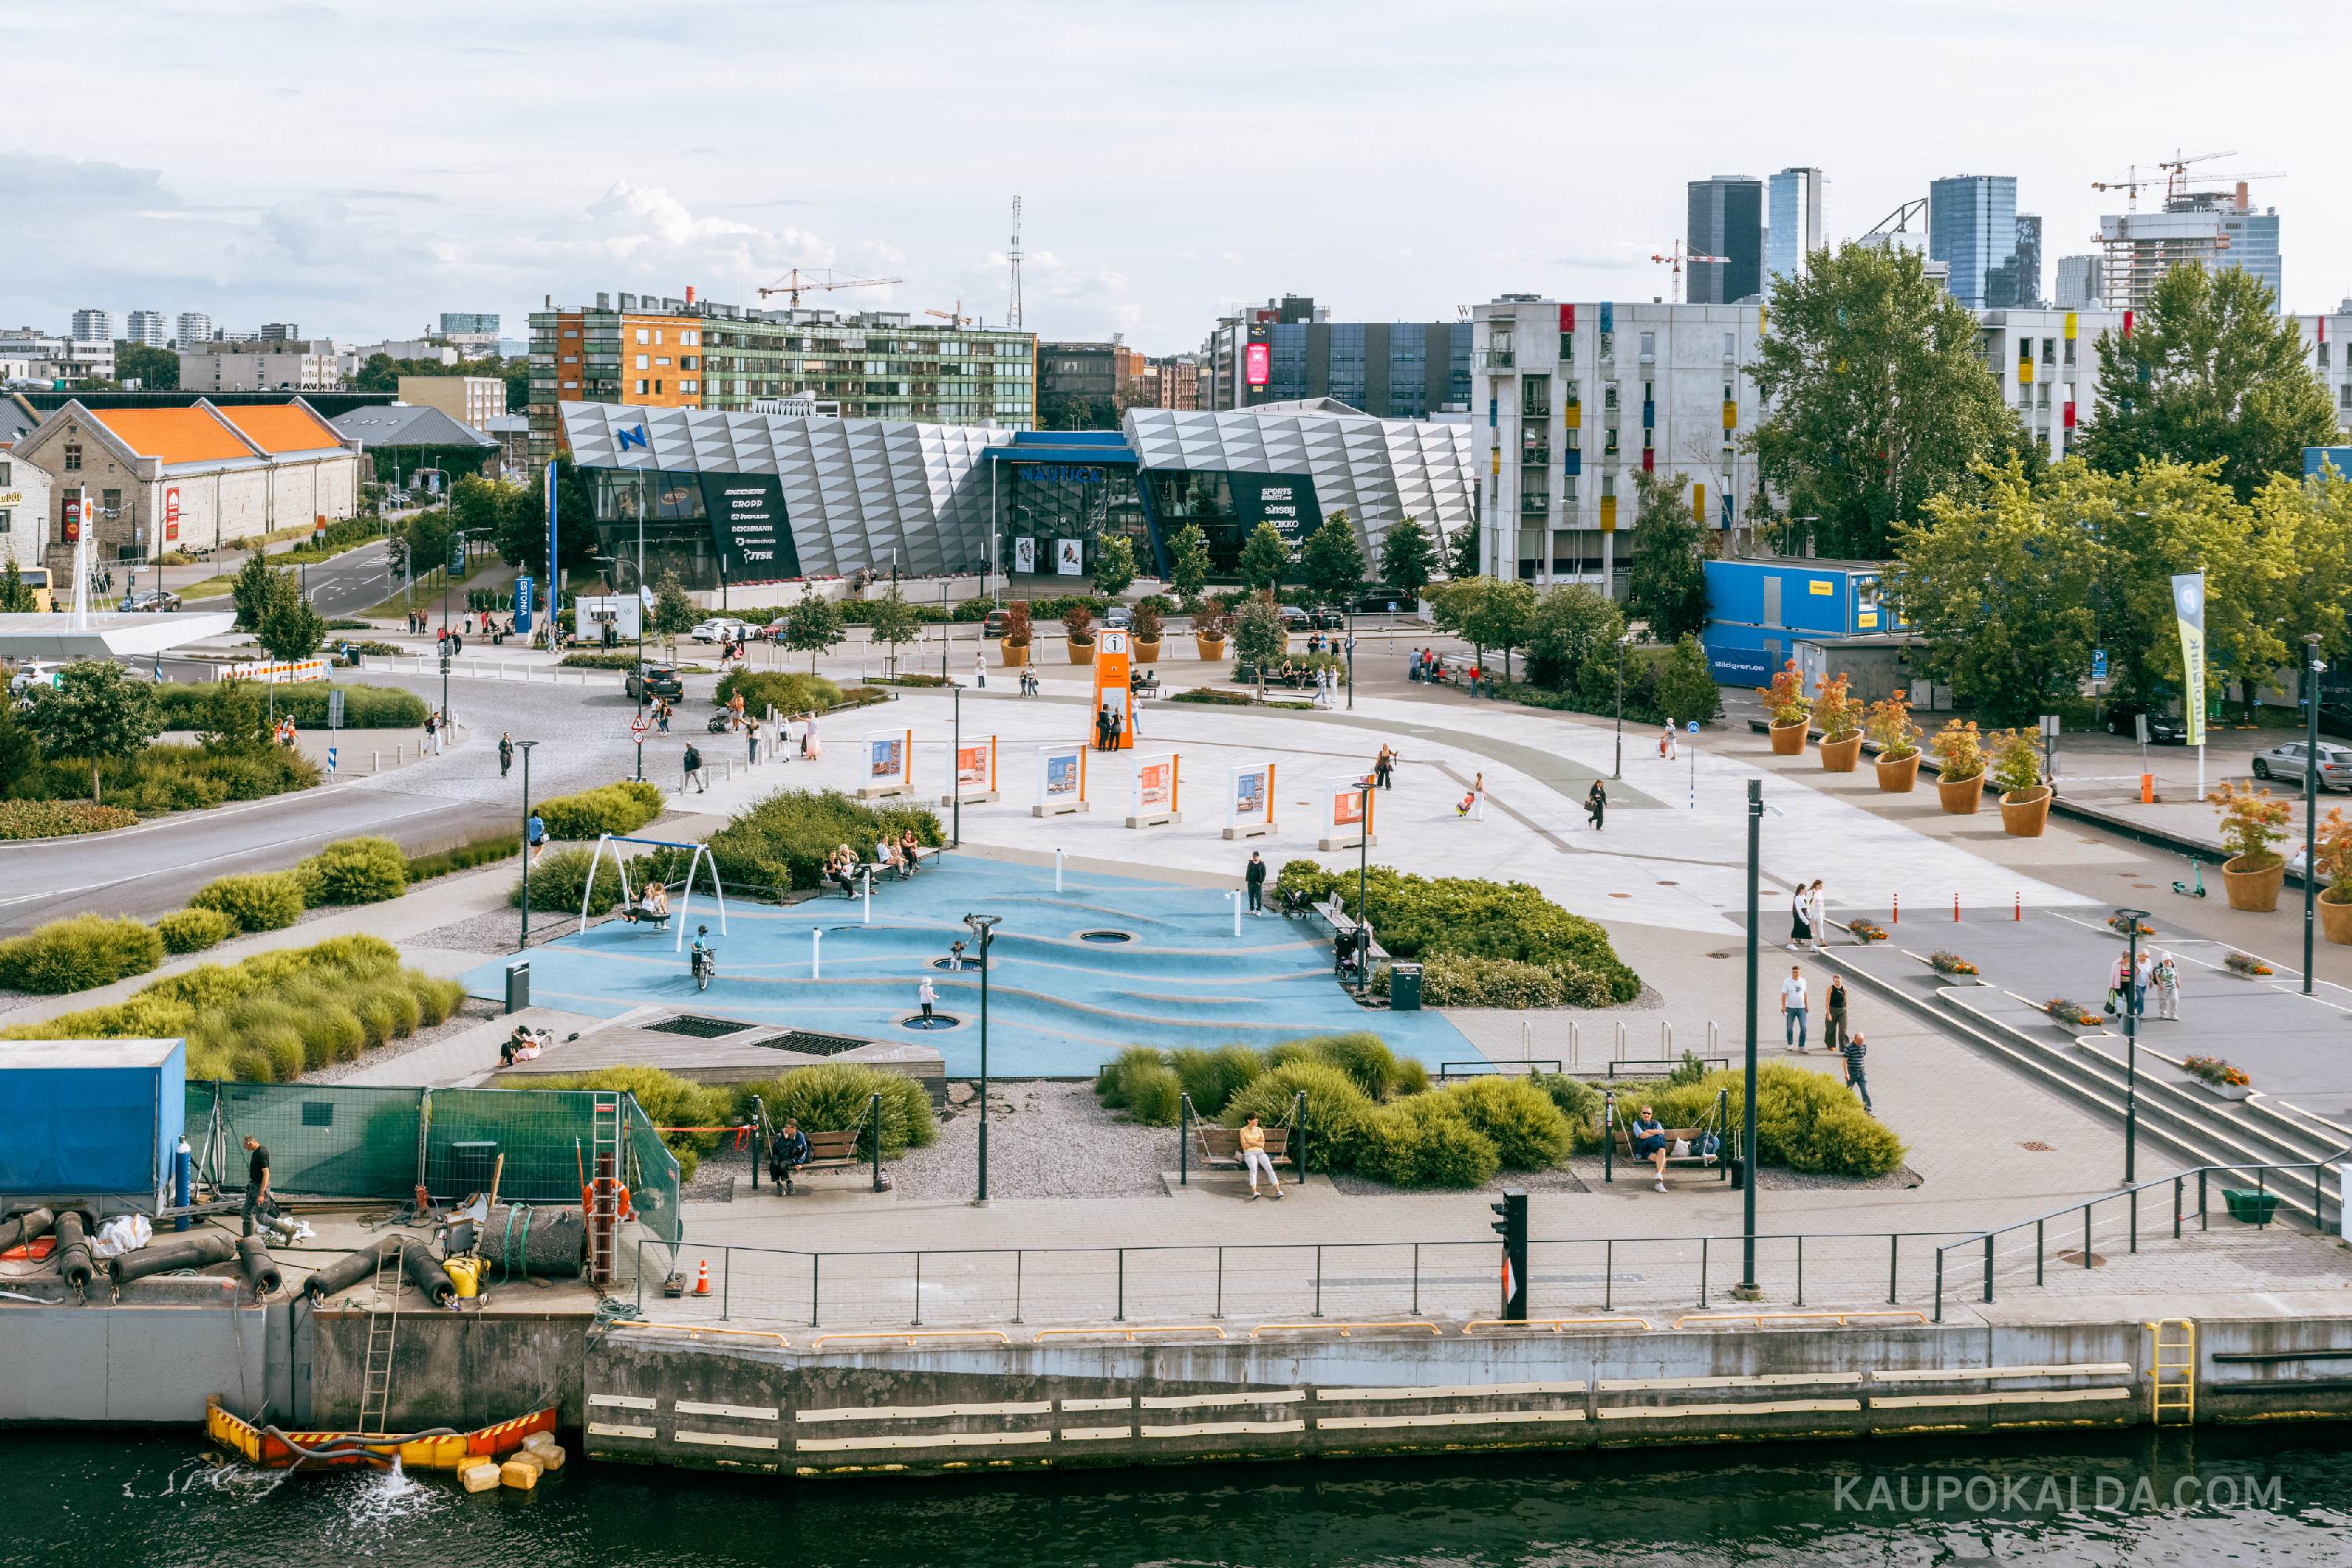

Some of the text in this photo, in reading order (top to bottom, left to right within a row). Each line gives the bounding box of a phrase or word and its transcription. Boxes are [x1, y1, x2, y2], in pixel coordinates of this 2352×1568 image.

[1022, 465, 1102, 484] NAUTICA
[731, 499, 763, 508] CROPP
[1265, 504, 1296, 517] sinsay
[749, 550, 774, 561] JYSK
[1715, 661, 1765, 671] Bildgren.ee
